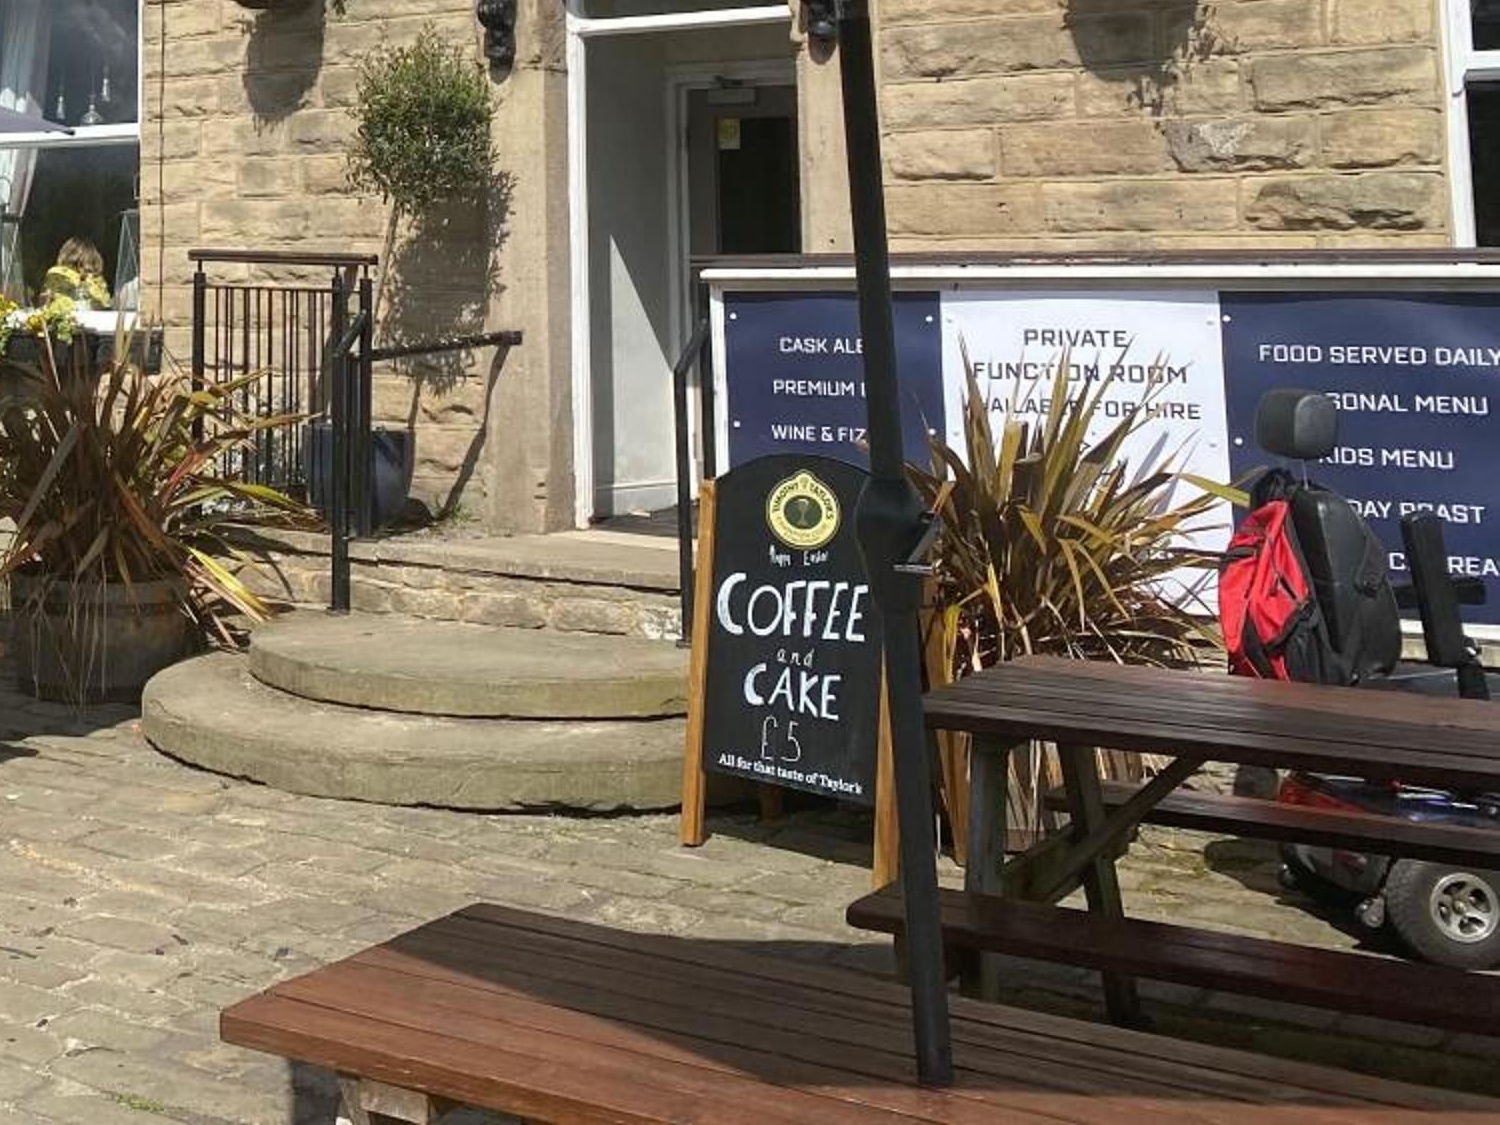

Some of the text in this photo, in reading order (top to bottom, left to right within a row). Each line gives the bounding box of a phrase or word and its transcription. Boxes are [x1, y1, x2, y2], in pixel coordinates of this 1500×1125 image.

[779, 336, 828, 355] CASK
[1023, 328, 1129, 348] PRIVATE
[1258, 344, 1500, 367] FOOD SERVED DAILY
[1109, 363, 1188, 384] ROOM
[772, 378, 856, 397] PREMIUM
[1414, 394, 1490, 416] MENU
[771, 424, 817, 442] WINE
[820, 425, 834, 443] &
[1381, 448, 1454, 470] MENU
[716, 571, 870, 643] COFFEE
[777, 646, 815, 669] and
[743, 662, 842, 722] CAKE
[760, 715, 802, 763] £5
[718, 752, 735, 768] All
[737, 756, 751, 770] for
[753, 760, 775, 776] that
[777, 766, 805, 782] taste
[805, 772, 819, 784] of
